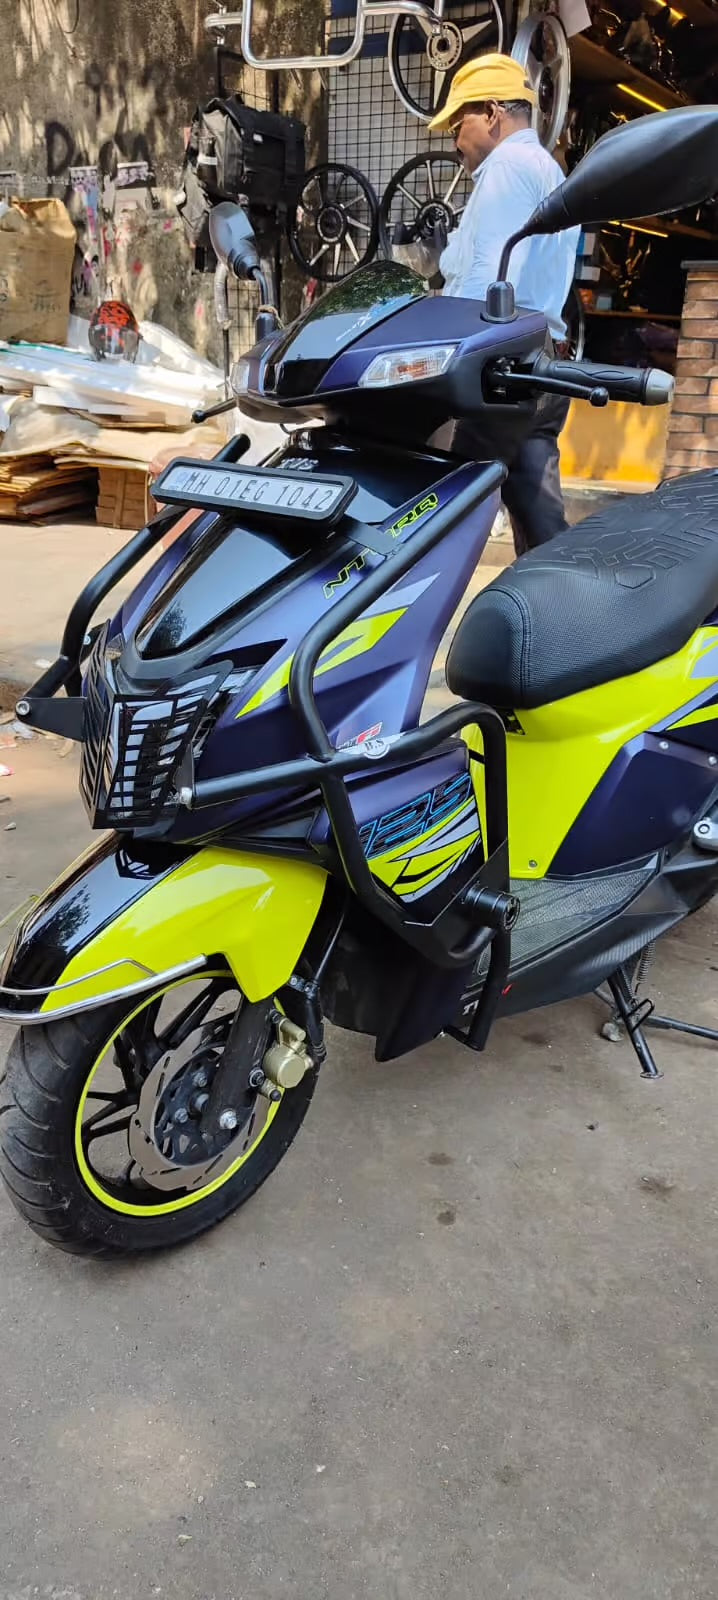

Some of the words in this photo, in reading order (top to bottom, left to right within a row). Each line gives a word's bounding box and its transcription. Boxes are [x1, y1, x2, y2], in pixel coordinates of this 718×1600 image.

[182, 470, 211, 493] MH
[214, 476, 269, 501] 01EG
[275, 484, 334, 511] 1042
[278, 457, 319, 471] TVS
[323, 492, 439, 599] NTRQ
[358, 772, 472, 861] 125
